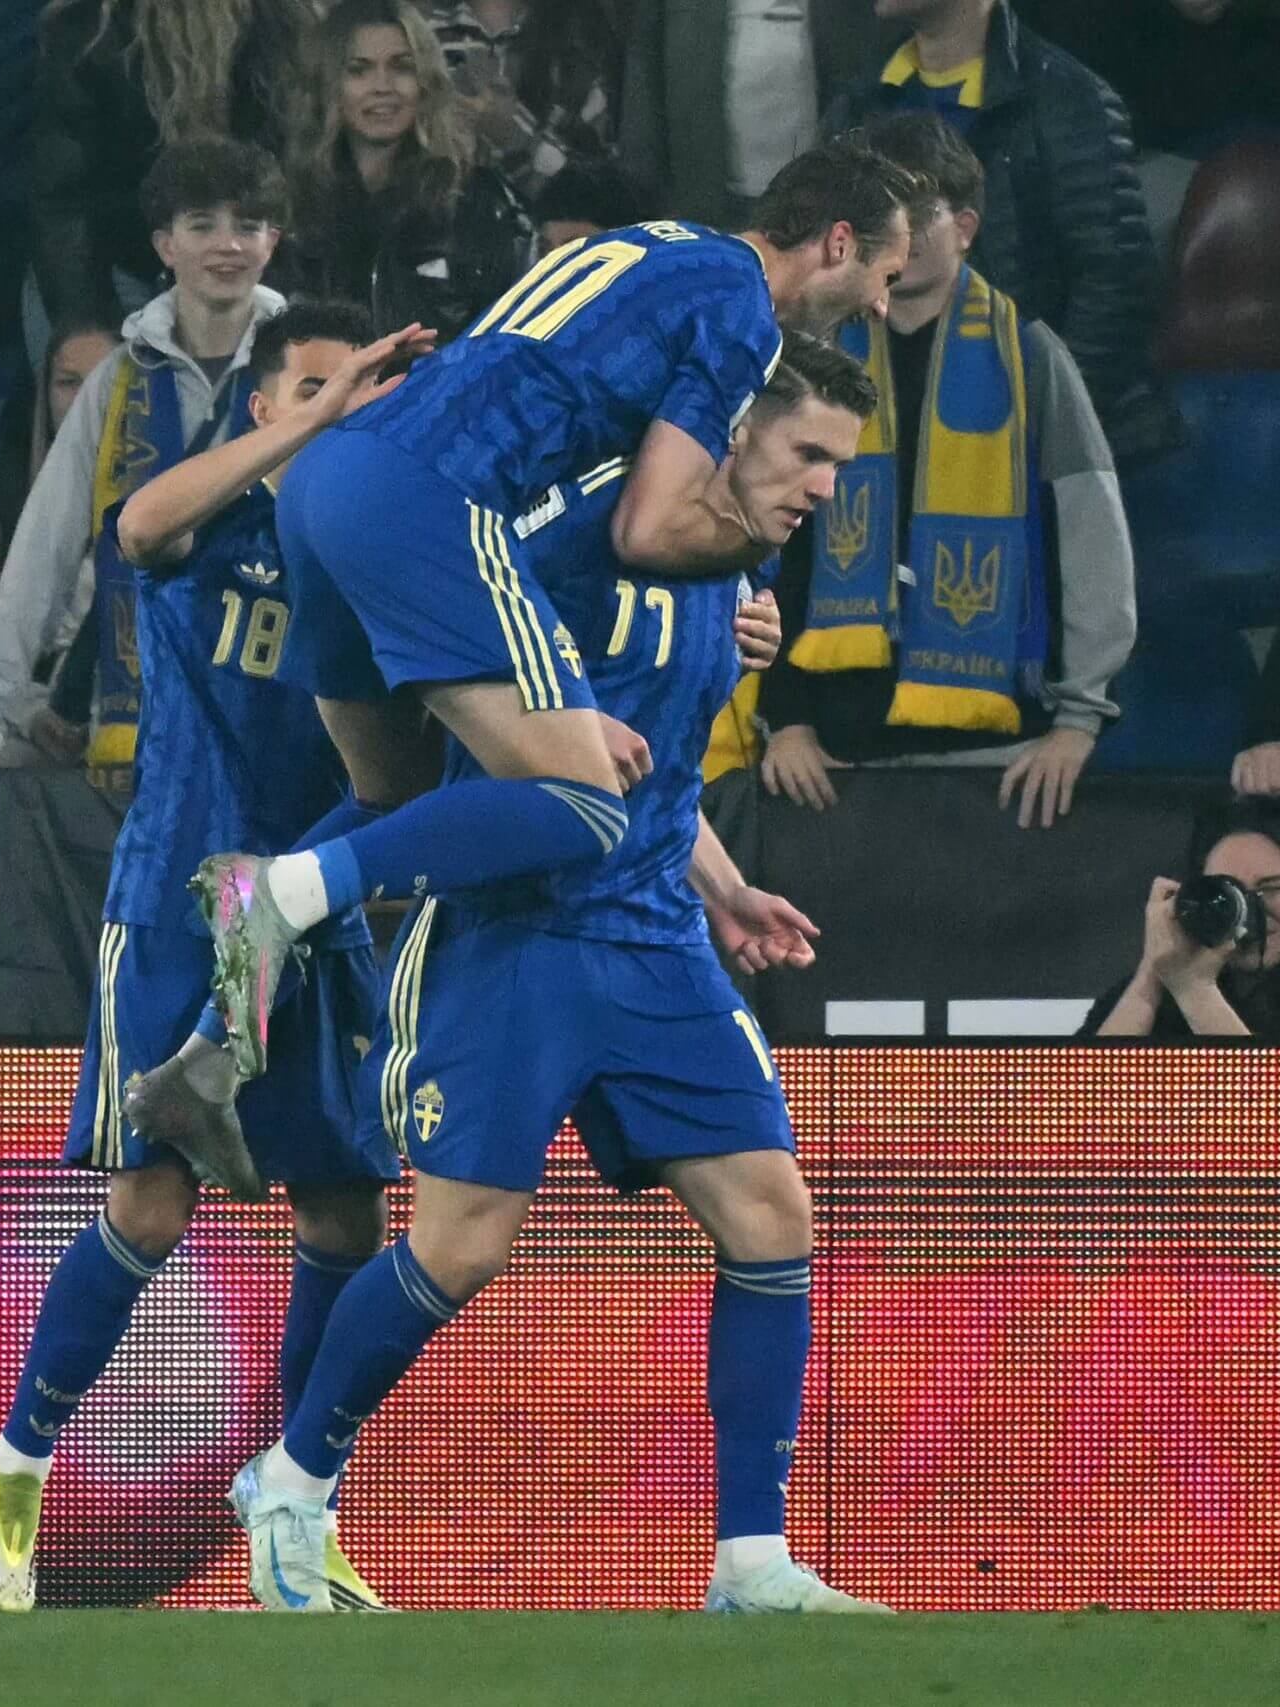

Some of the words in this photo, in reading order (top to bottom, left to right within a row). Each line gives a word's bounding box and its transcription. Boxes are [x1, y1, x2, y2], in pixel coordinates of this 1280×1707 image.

[467, 236, 648, 341] 10
[212, 588, 290, 679] 18
[607, 579, 674, 668] 17
